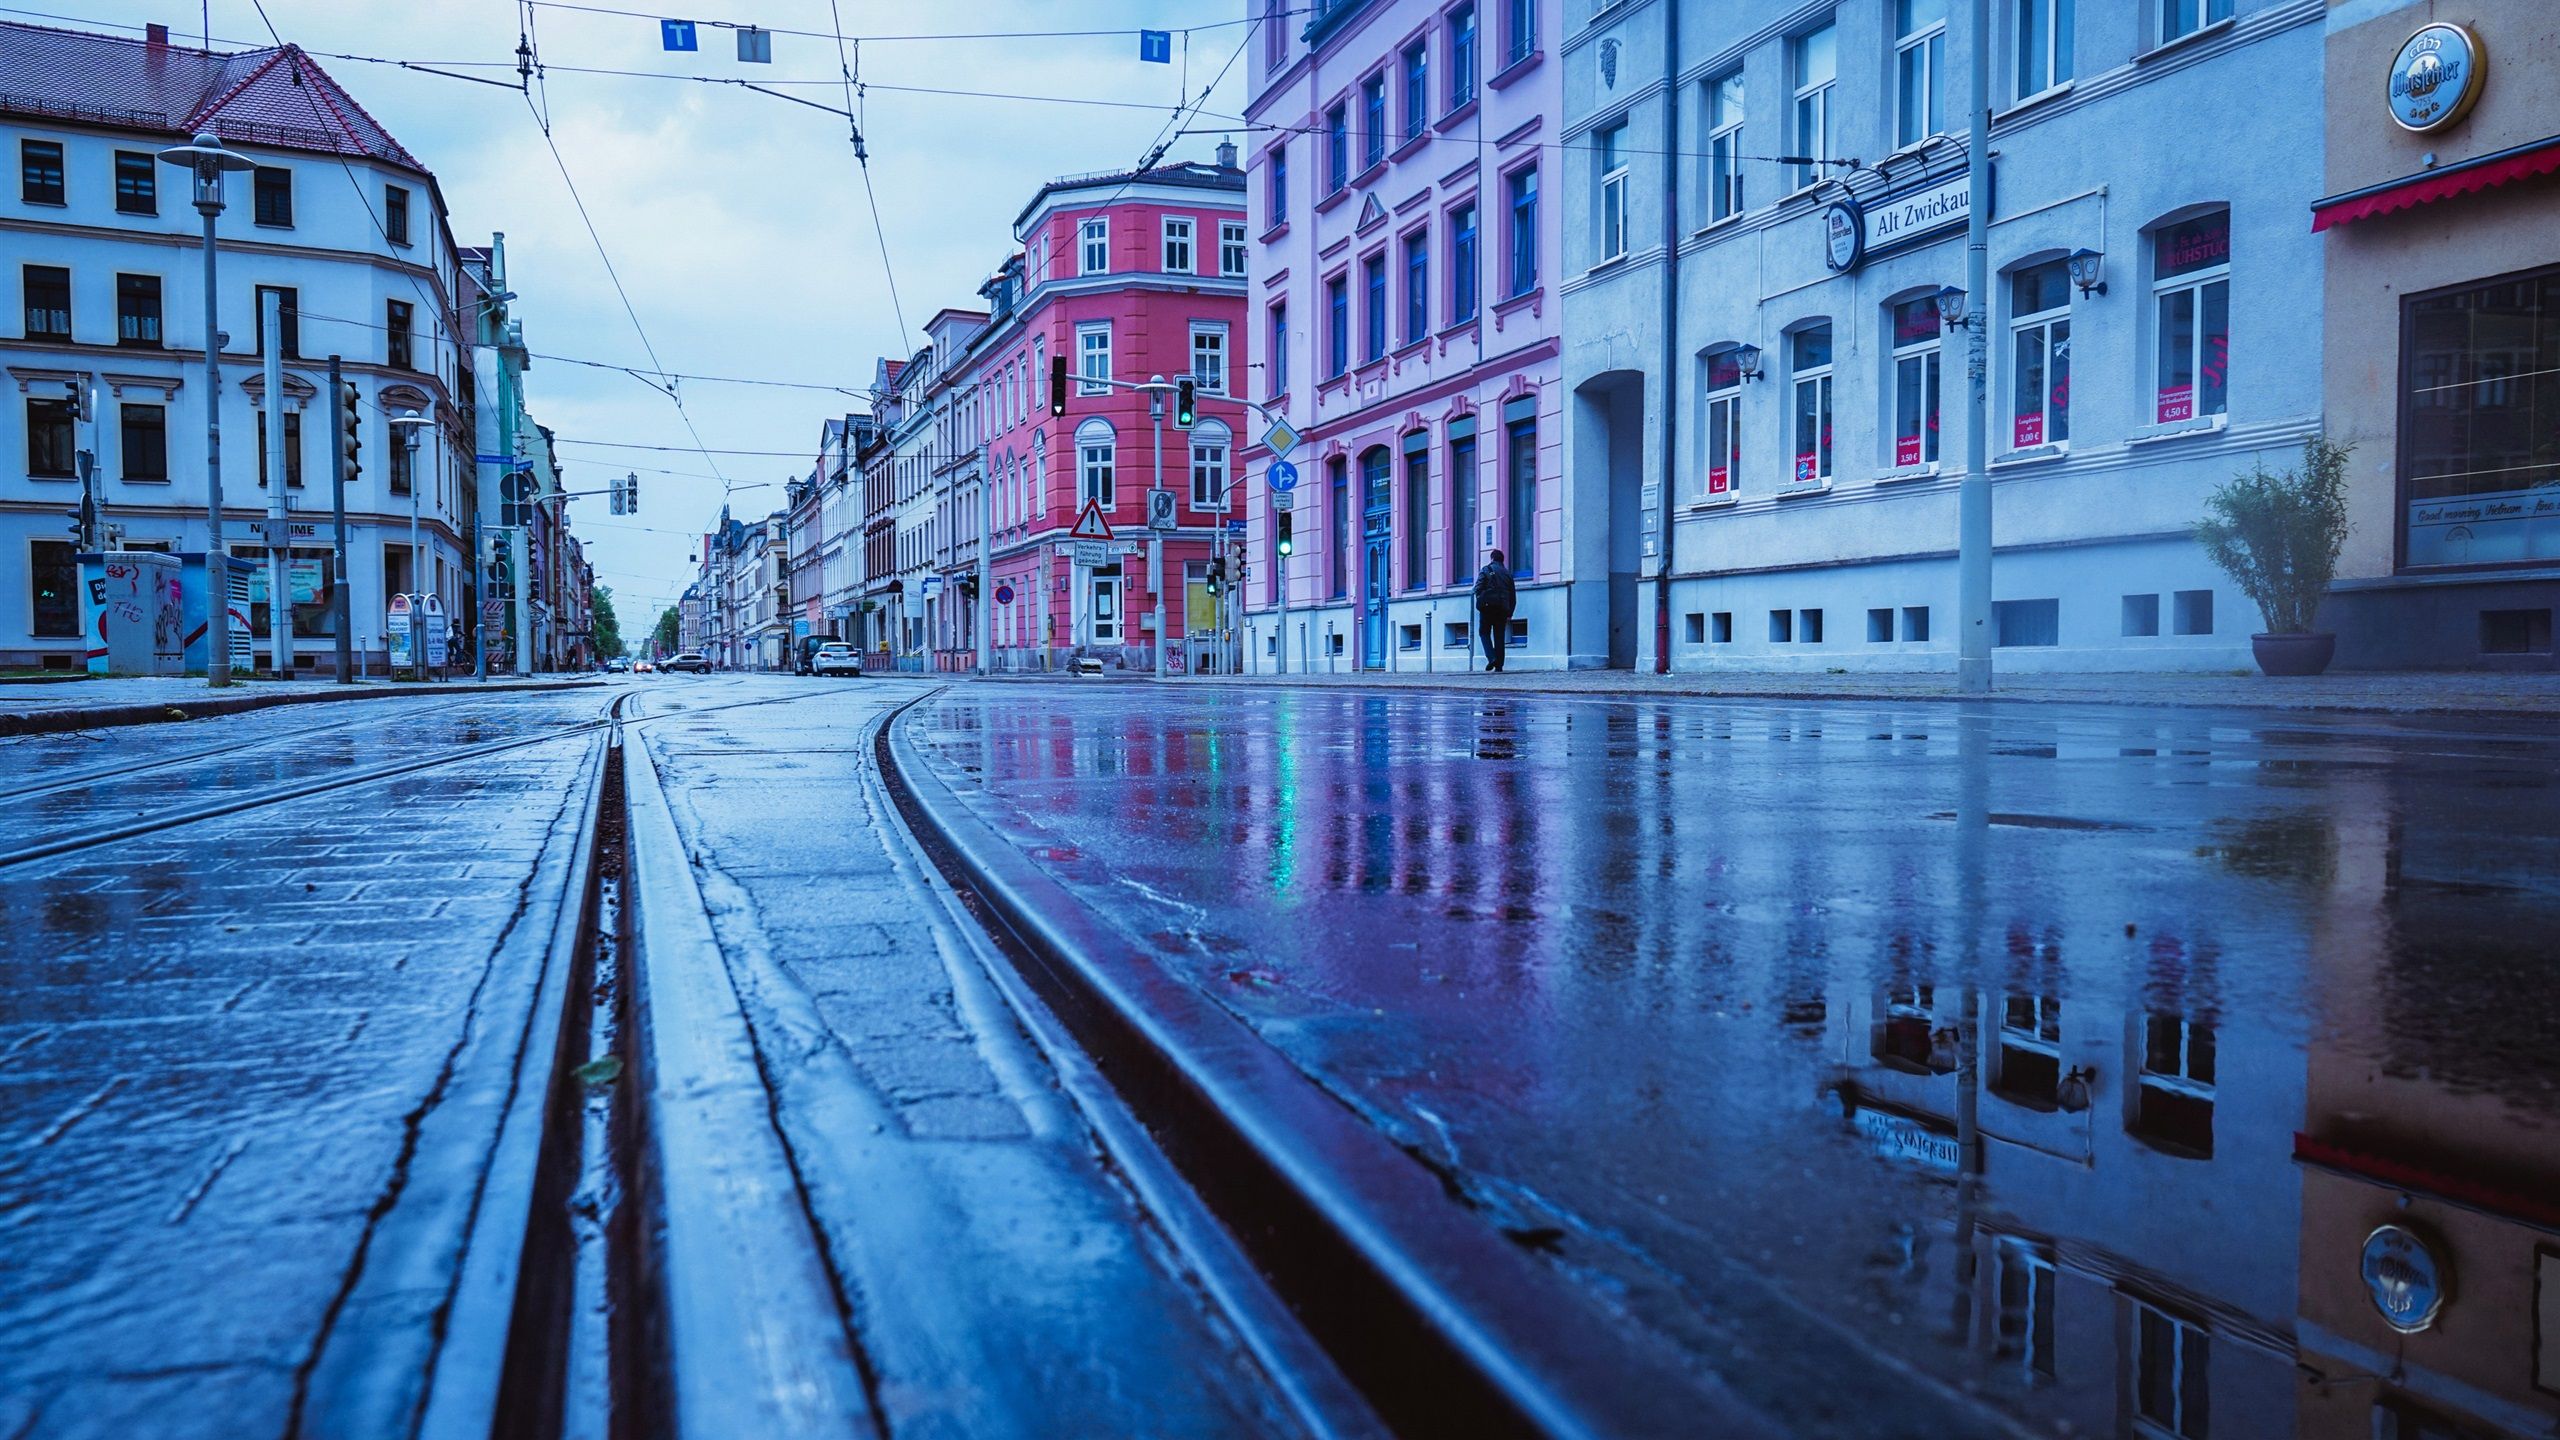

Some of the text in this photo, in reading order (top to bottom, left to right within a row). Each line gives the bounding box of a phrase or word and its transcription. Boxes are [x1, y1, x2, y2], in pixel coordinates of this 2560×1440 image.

[668, 24, 689, 47] T
[1146, 35, 1165, 58] T
[2392, 60, 2461, 98] Warsteiner
[2416, 97, 2432, 107] 1753
[1876, 190, 1970, 237] Alt Zwickau
[2164, 405, 2188, 418] 4,50 €
[2019, 431, 2040, 443] 3,00 €
[1900, 452, 1918, 463] 3,50 €
[2417, 507, 2443, 522] Good
[2444, 506, 2481, 520] morning
[2485, 502, 2522, 515] Vietnam
[1077, 543, 1105, 551] Verkehrs-
[1078, 557, 1103, 565] geändert
[1079, 551, 1102, 559] führung
